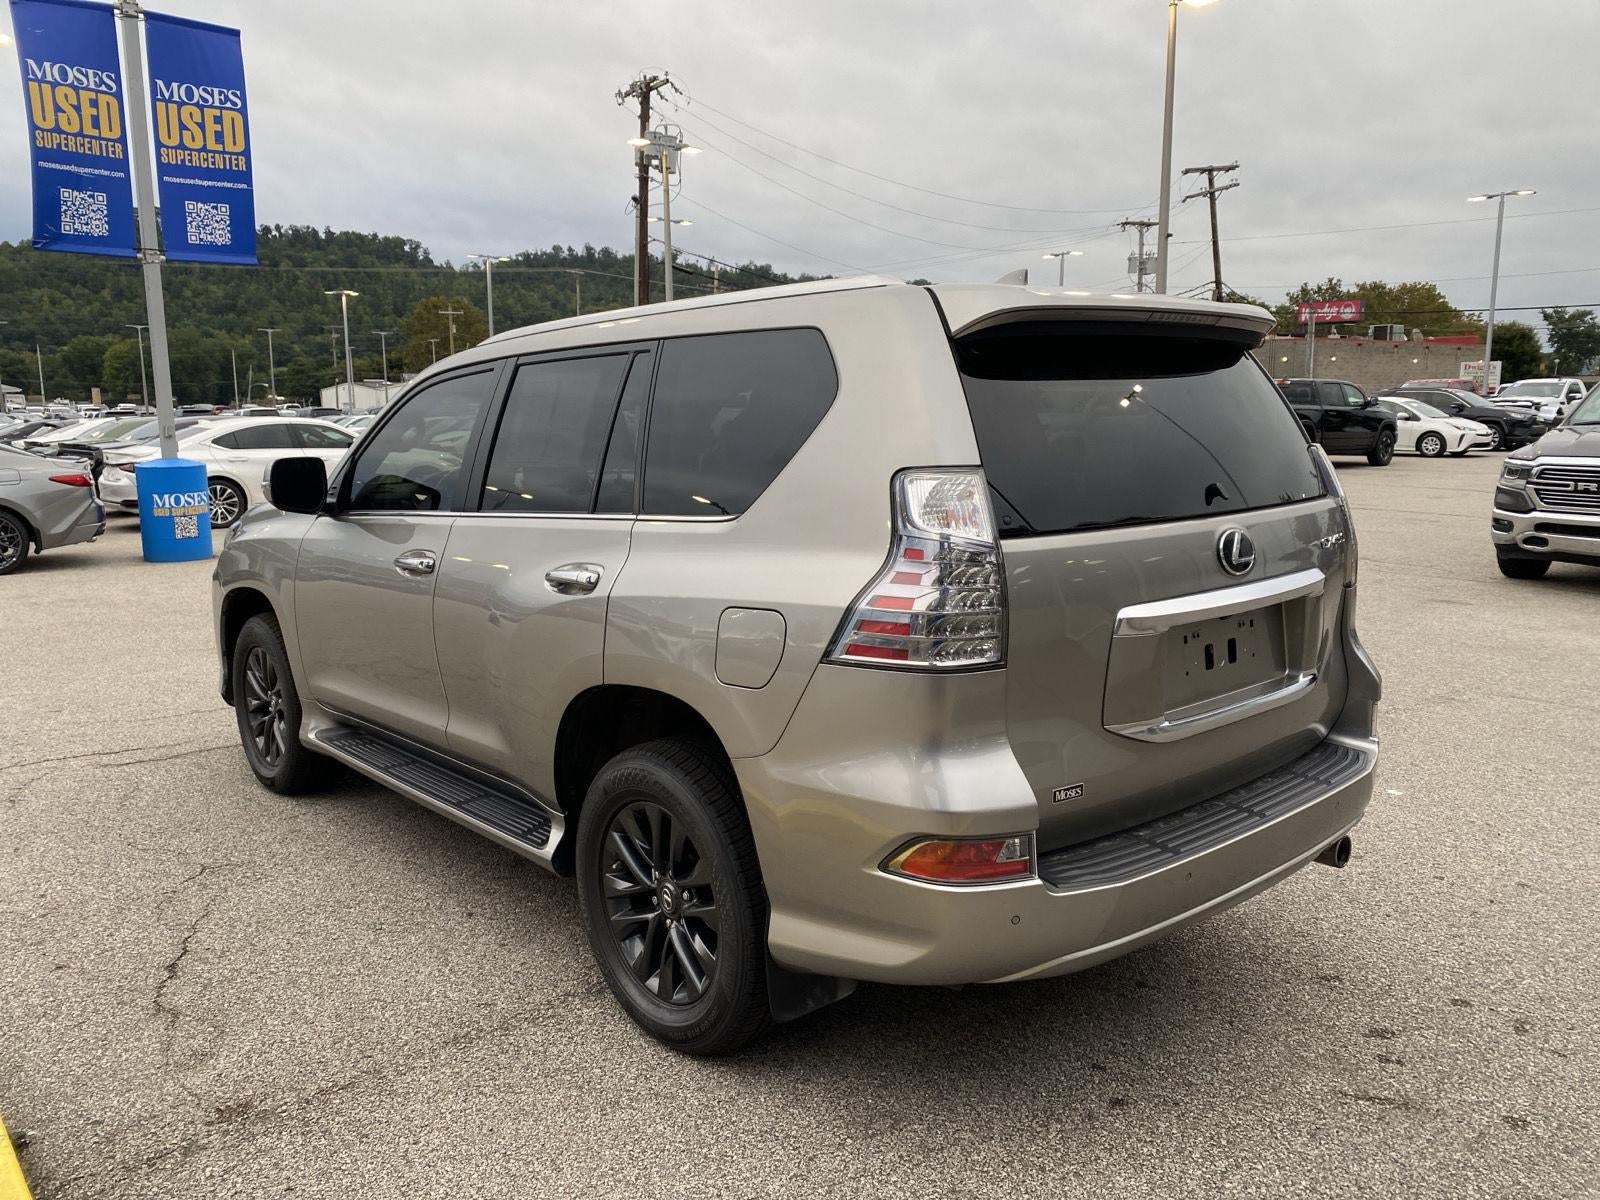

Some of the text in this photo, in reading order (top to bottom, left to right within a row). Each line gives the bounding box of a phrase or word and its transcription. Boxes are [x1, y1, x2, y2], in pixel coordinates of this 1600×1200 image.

[25, 58, 117, 93] MOSES
[154, 79, 242, 109] MOSES
[28, 81, 121, 139] USED
[156, 101, 245, 152] USED
[35, 130, 123, 159] SUPERCENTER
[38, 161, 125, 178] mosesusedsupercenter.com
[160, 148, 246, 171] SUPERCENTER
[152, 491, 208, 508] MOSES
[1055, 787, 1082, 802] MOSES
